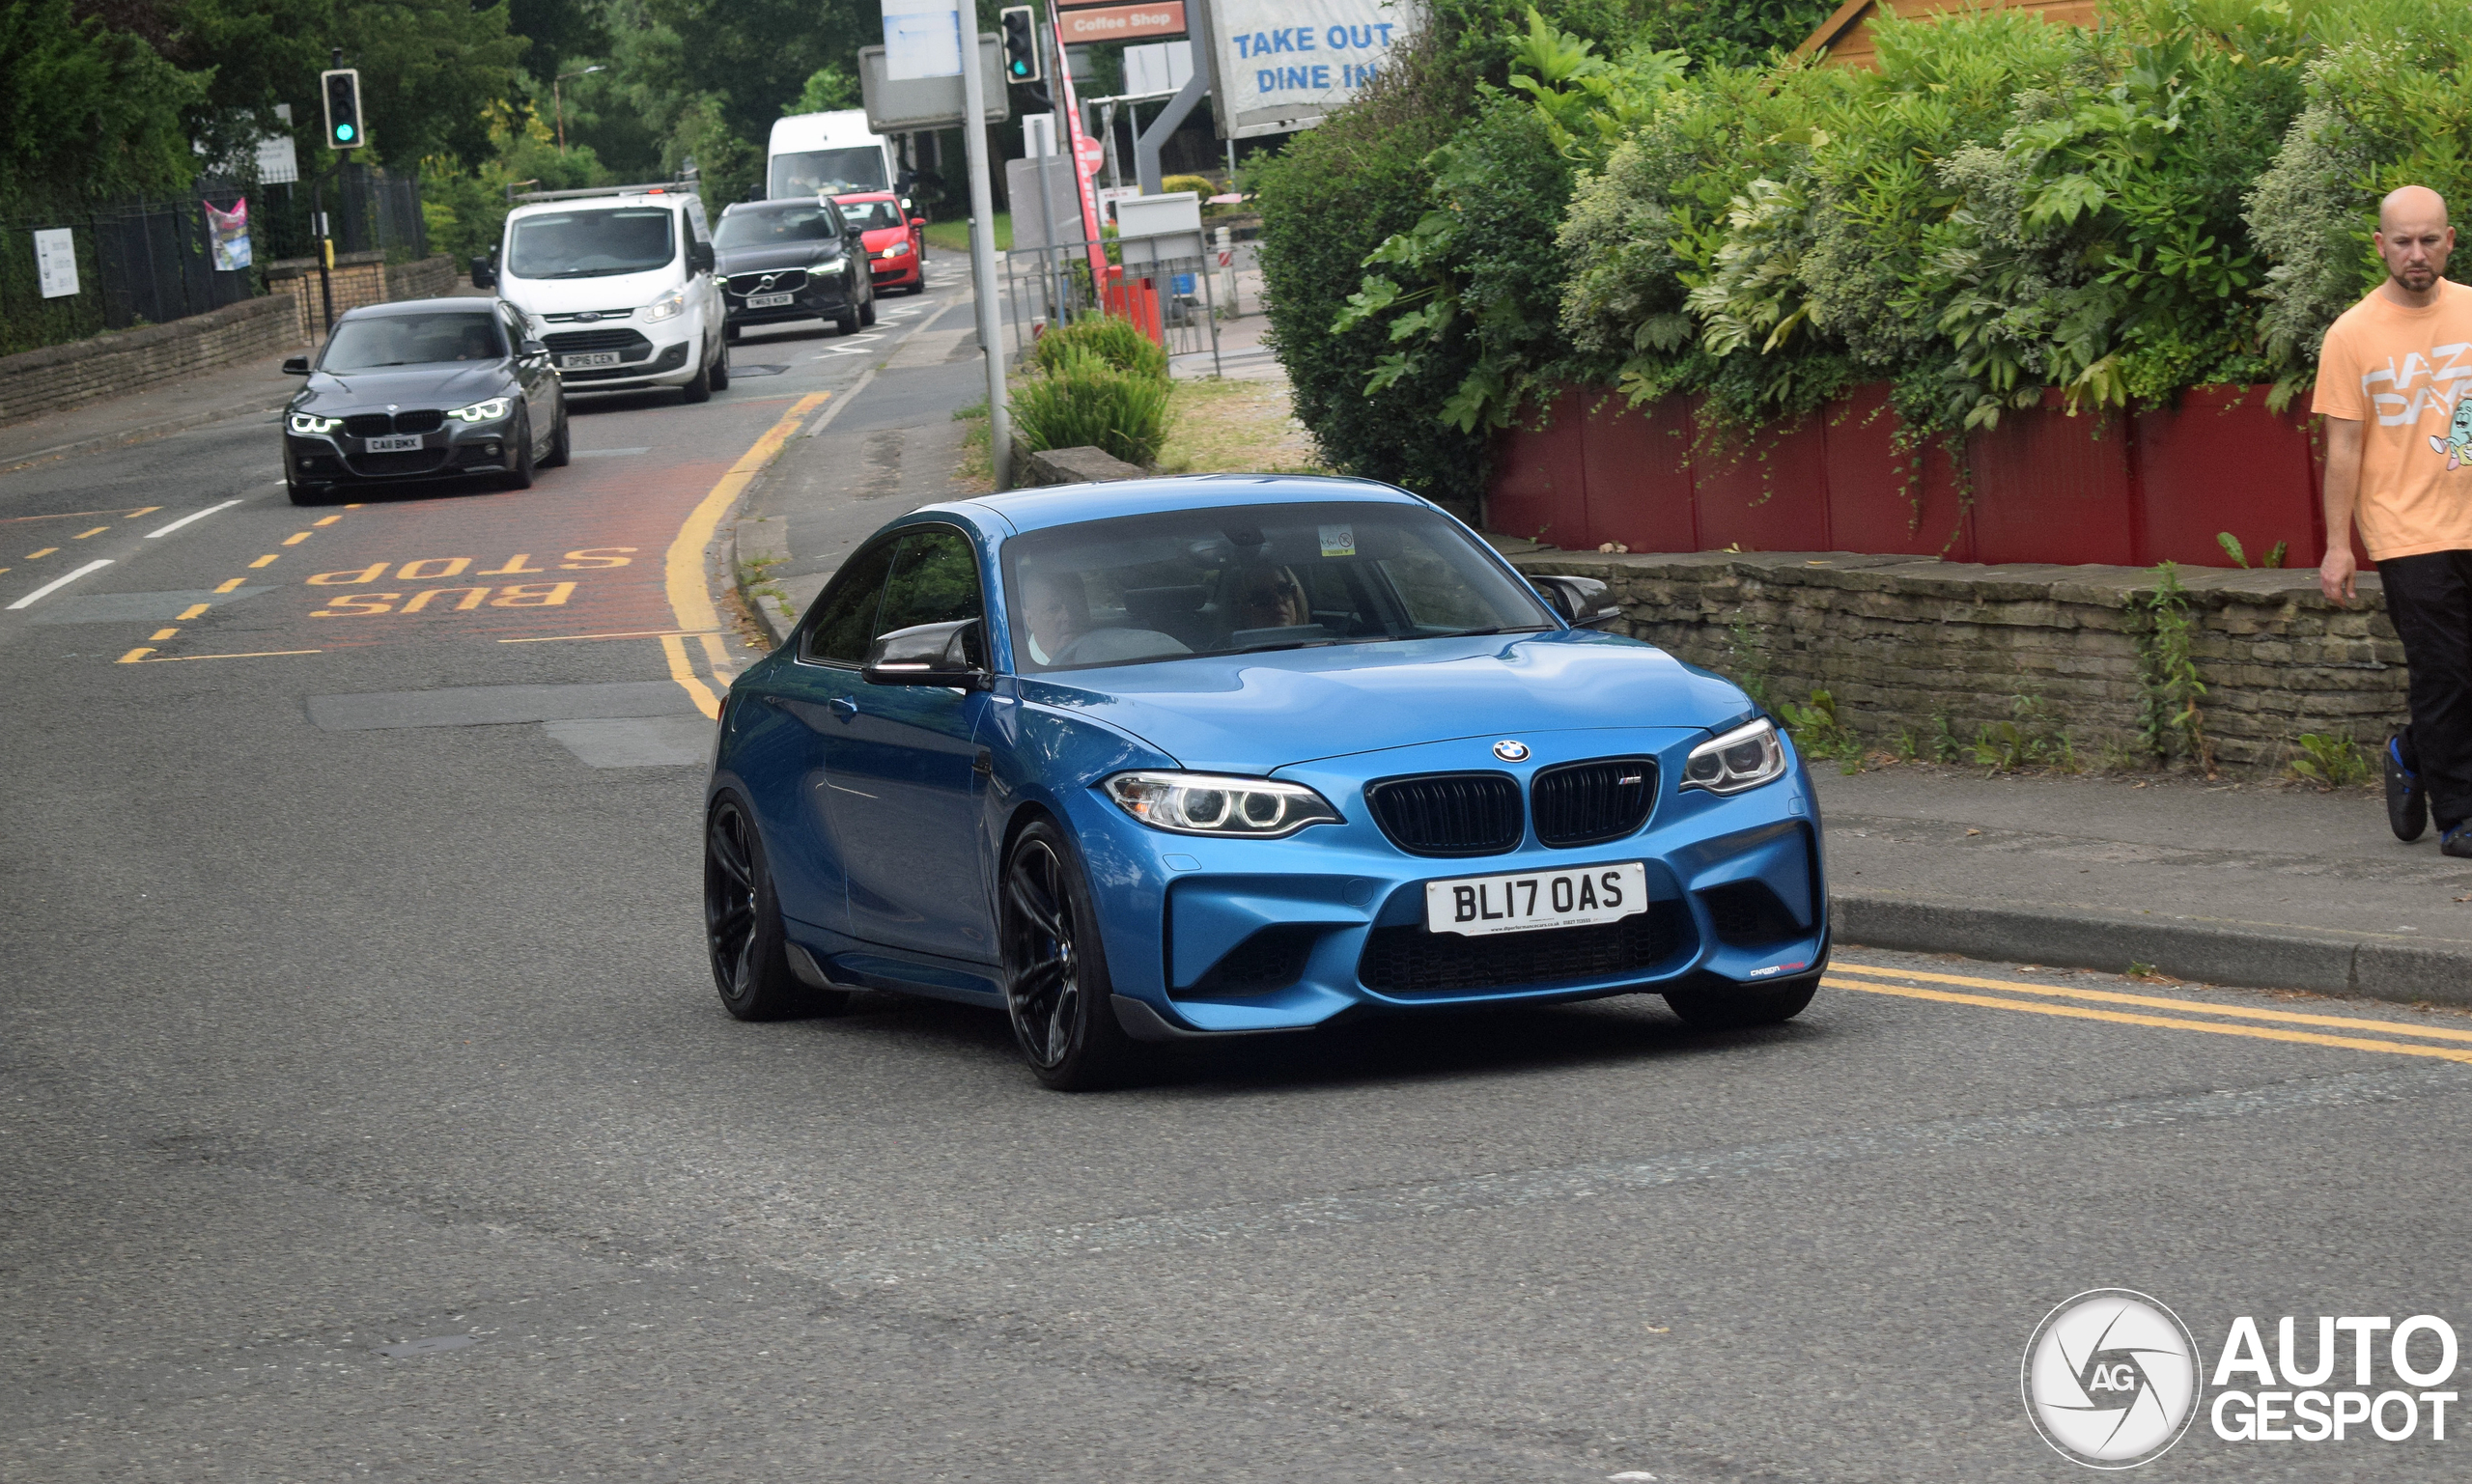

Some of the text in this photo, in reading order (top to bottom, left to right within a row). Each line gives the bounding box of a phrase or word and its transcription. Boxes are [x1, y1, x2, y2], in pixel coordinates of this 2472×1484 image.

[1074, 14, 1170, 32] Coffee Shop
[1233, 23, 1393, 59] TAKE OUT
[1257, 63, 1377, 93] DINE IN
[305, 547, 638, 584] STOP
[308, 581, 577, 617] BUS
[1452, 871, 1623, 922] BL17 OAS
